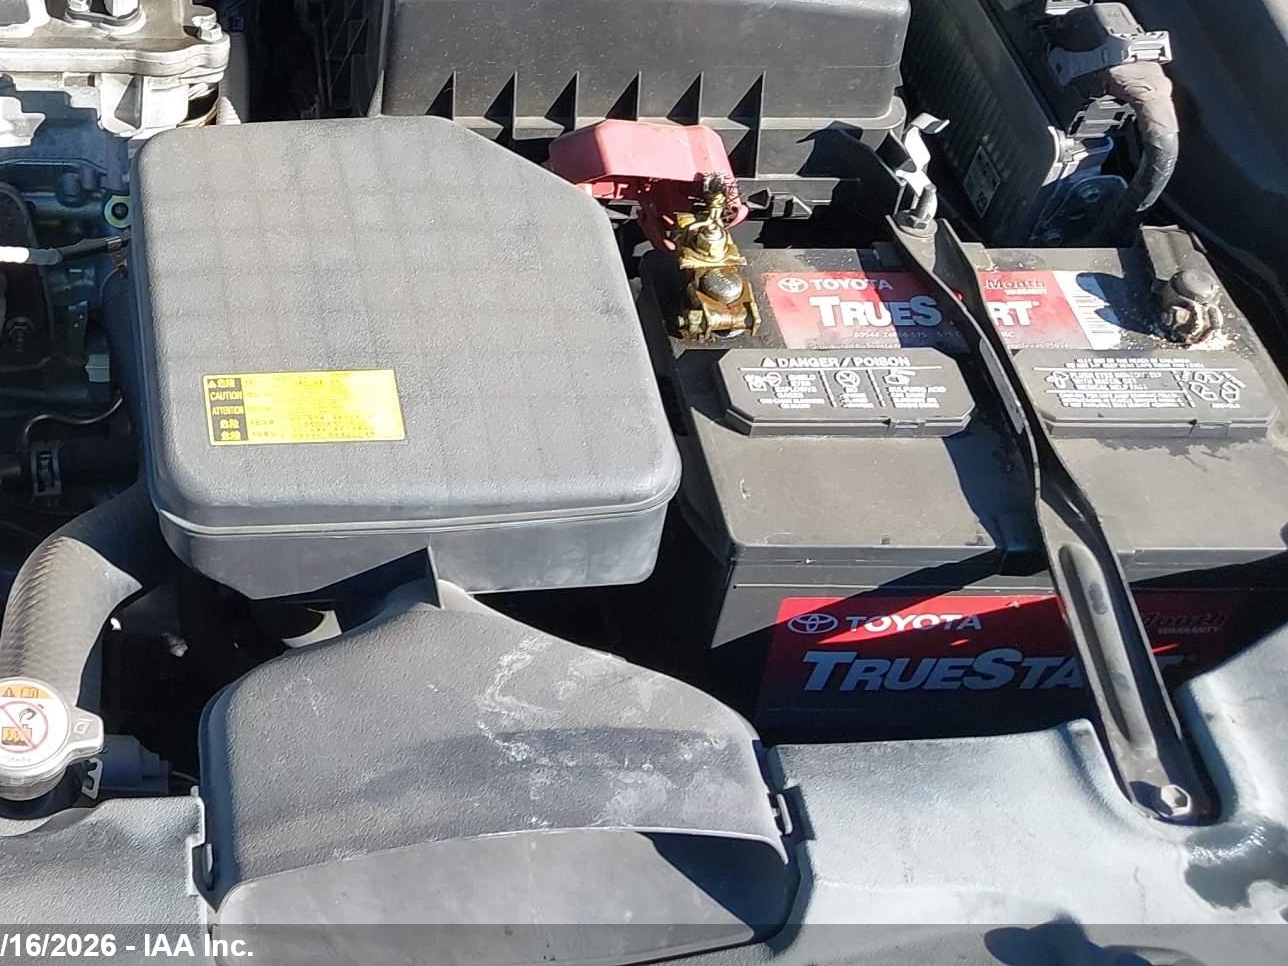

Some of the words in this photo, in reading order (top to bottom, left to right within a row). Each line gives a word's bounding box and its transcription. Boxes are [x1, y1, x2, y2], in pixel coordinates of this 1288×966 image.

[809, 278, 894, 291] TOYOTA
[777, 357, 840, 368] DANGER
[854, 356, 911, 367] POISON
[209, 390, 243, 401] CAUTION
[845, 613, 982, 632] TOYOTA
